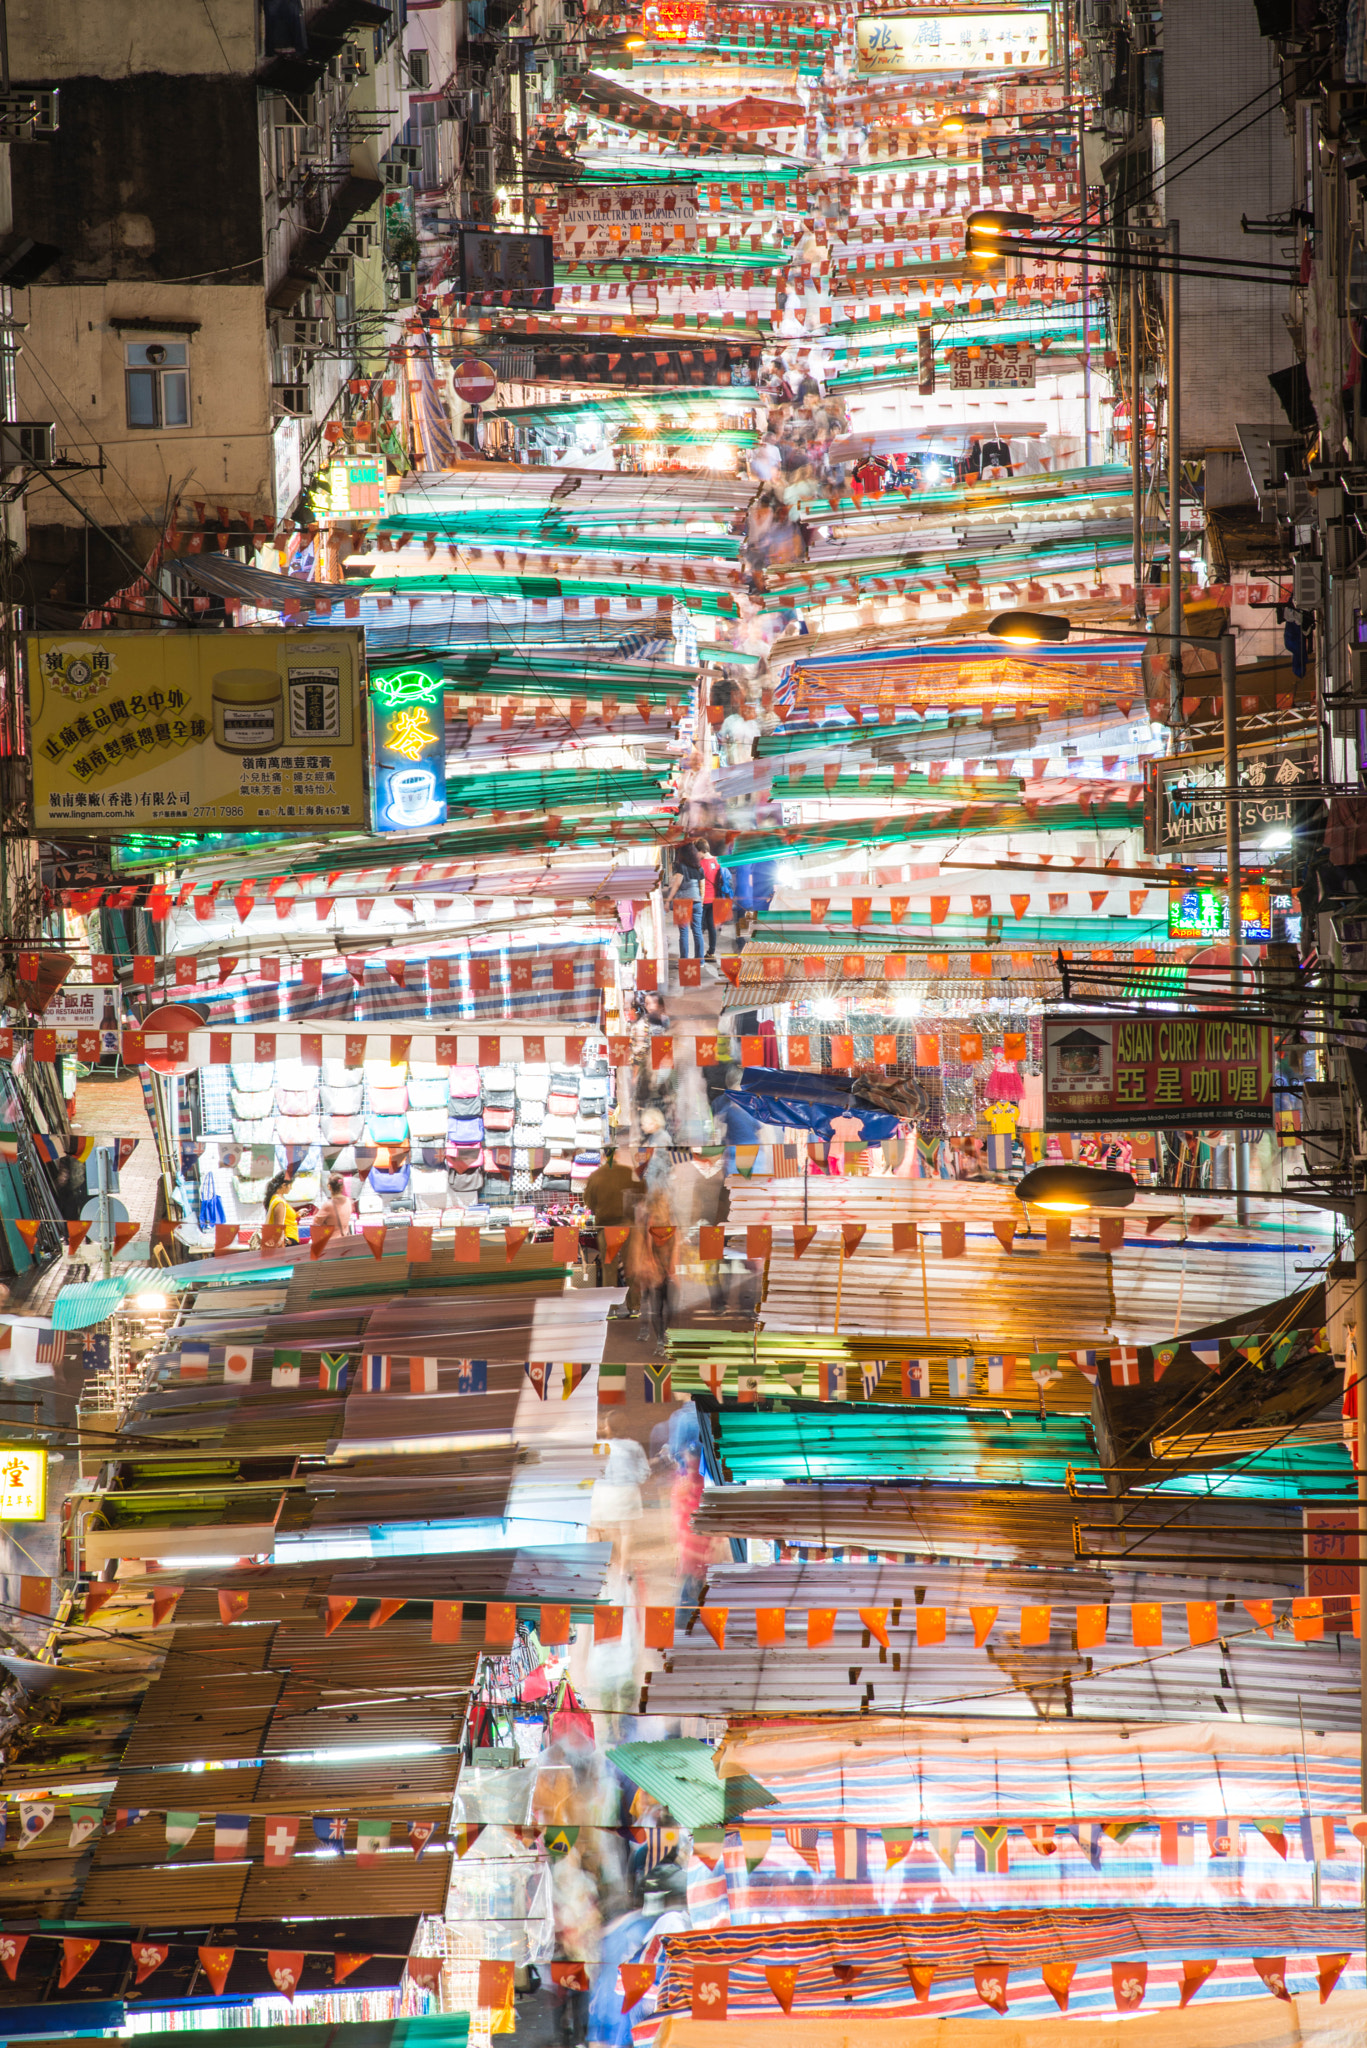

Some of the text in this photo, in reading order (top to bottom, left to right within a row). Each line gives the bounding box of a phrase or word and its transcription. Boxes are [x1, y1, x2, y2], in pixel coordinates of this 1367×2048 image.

[563, 207, 694, 222] LAI SUN ELECTRIC DEVELOPMENT CO
[974, 365, 1033, 380] 理髮公司
[349, 468, 378, 483] GAME
[45, 689, 184, 759] 止痛產品聞名中外
[49, 810, 135, 820] www.lingnam.com.hk
[193, 807, 216, 817] 2771
[220, 806, 244, 816] 7986
[1166, 809, 1257, 838] WINNES
[1223, 919, 1261, 928] FING
[1171, 928, 1201, 937] Apple
[1116, 1021, 1257, 1063] ASIAN CURRY KITCHEN
[1115, 1065, 1258, 1103] 亞星咖喱
[2, 1457, 29, 1487] 堂
[1313, 1520, 1346, 1556] 新
[1313, 1568, 1355, 1587] SUN
